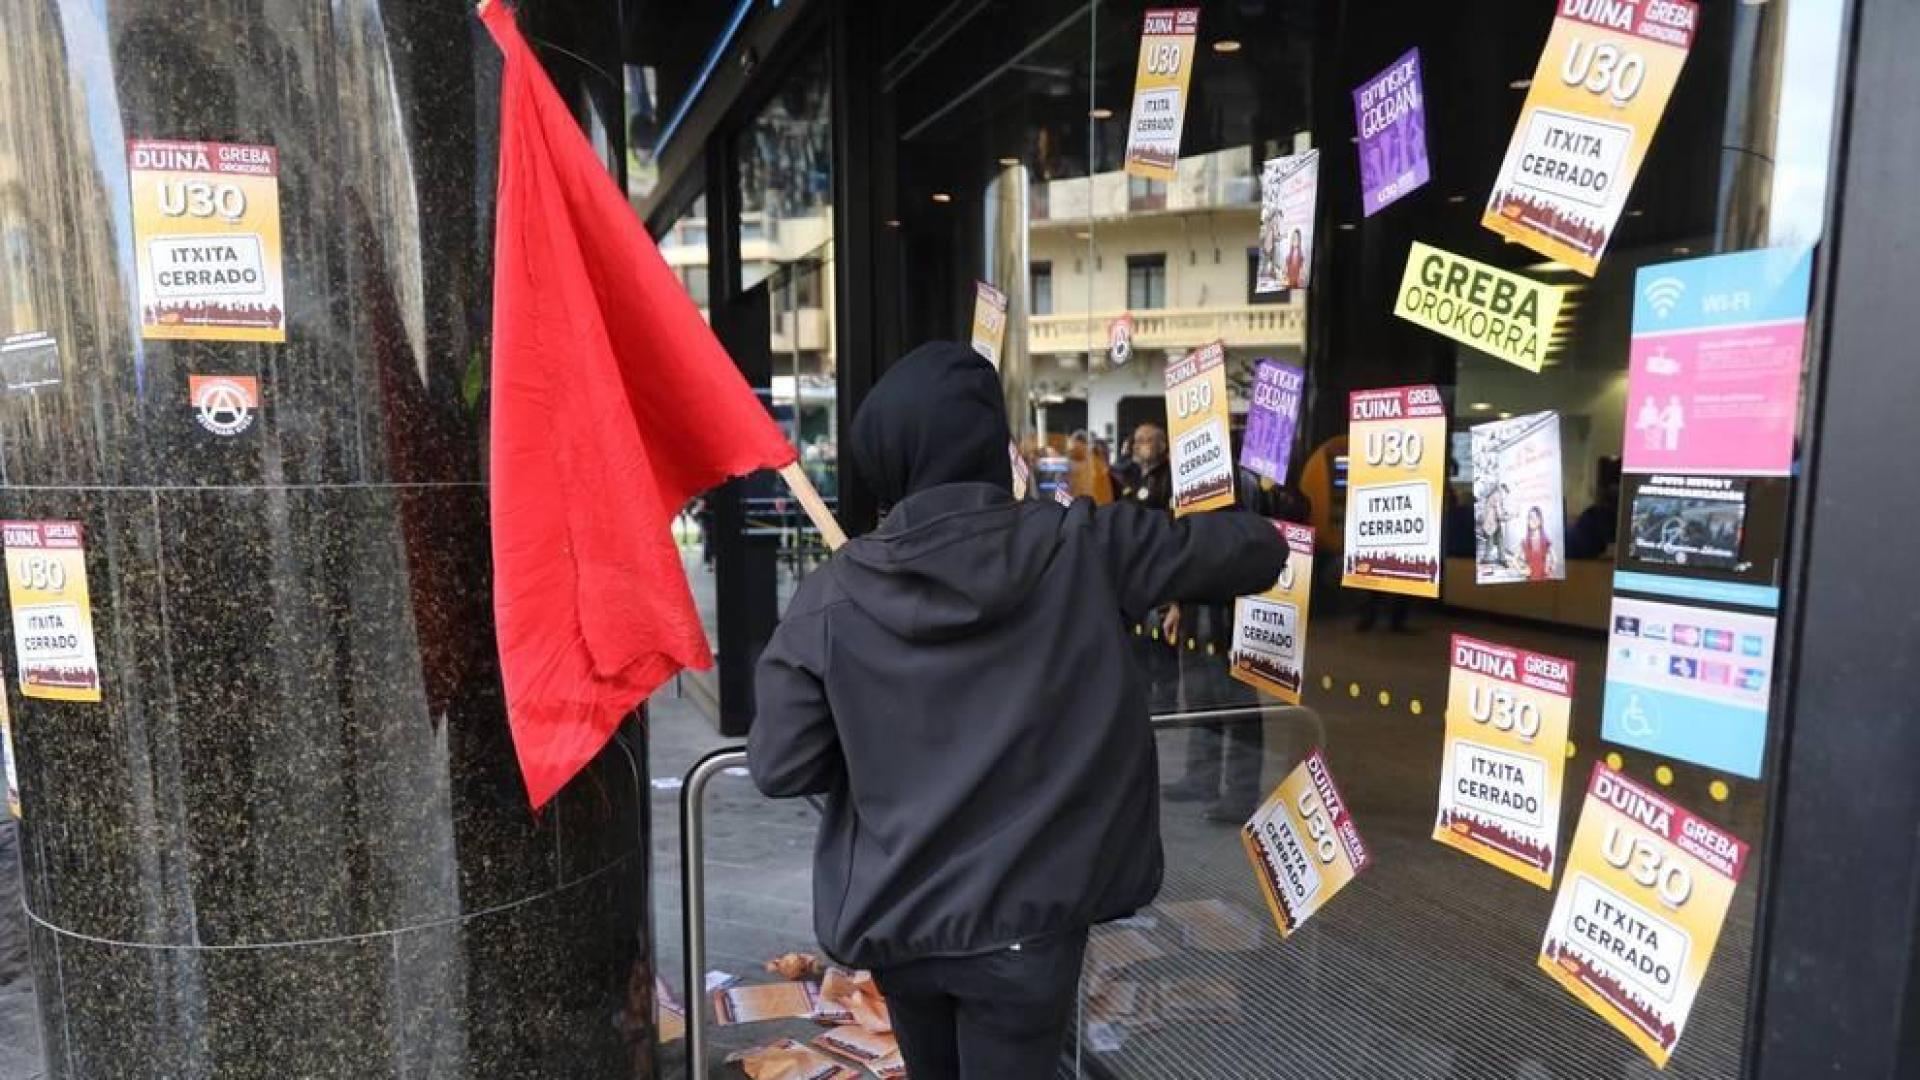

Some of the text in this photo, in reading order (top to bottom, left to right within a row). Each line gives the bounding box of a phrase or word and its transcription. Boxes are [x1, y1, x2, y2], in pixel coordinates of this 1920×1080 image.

[1147, 43, 1180, 74] U30
[1562, 38, 1646, 103] U30
[135, 146, 271, 170] DUINA GREBA
[1544, 127, 1603, 159] ITXITA
[1521, 153, 1608, 192] CERRADO
[157, 182, 245, 218] U30
[172, 246, 237, 263] ITXITA
[158, 268, 257, 287] CERRADO
[1421, 253, 1539, 328] GREBA
[1405, 286, 1537, 361] OROKORRA
[1179, 379, 1212, 418] U30
[1353, 399, 1402, 419] DUINA
[1367, 430, 1422, 467] U30
[1368, 496, 1412, 513] ITXITA
[1359, 517, 1424, 536] CERRADO
[21, 556, 65, 590] U30
[29, 615, 64, 630] ITXITA
[1244, 626, 1293, 648] CERRADO
[25, 634, 77, 651] CERRADO
[1456, 647, 1516, 681] DUINA
[1524, 656, 1569, 681] GREBA
[1470, 685, 1541, 739] U30
[1471, 755, 1525, 786] ITXITA
[1458, 777, 1537, 815] CERRADO
[1298, 791, 1336, 863] U30
[1596, 775, 1671, 837] DUINA
[1682, 817, 1739, 864] GREBA
[1266, 822, 1305, 897] CERRADO
[1602, 826, 1693, 908] U30
[1594, 898, 1659, 950] ITXITA
[1574, 914, 1671, 986] CERRADO
